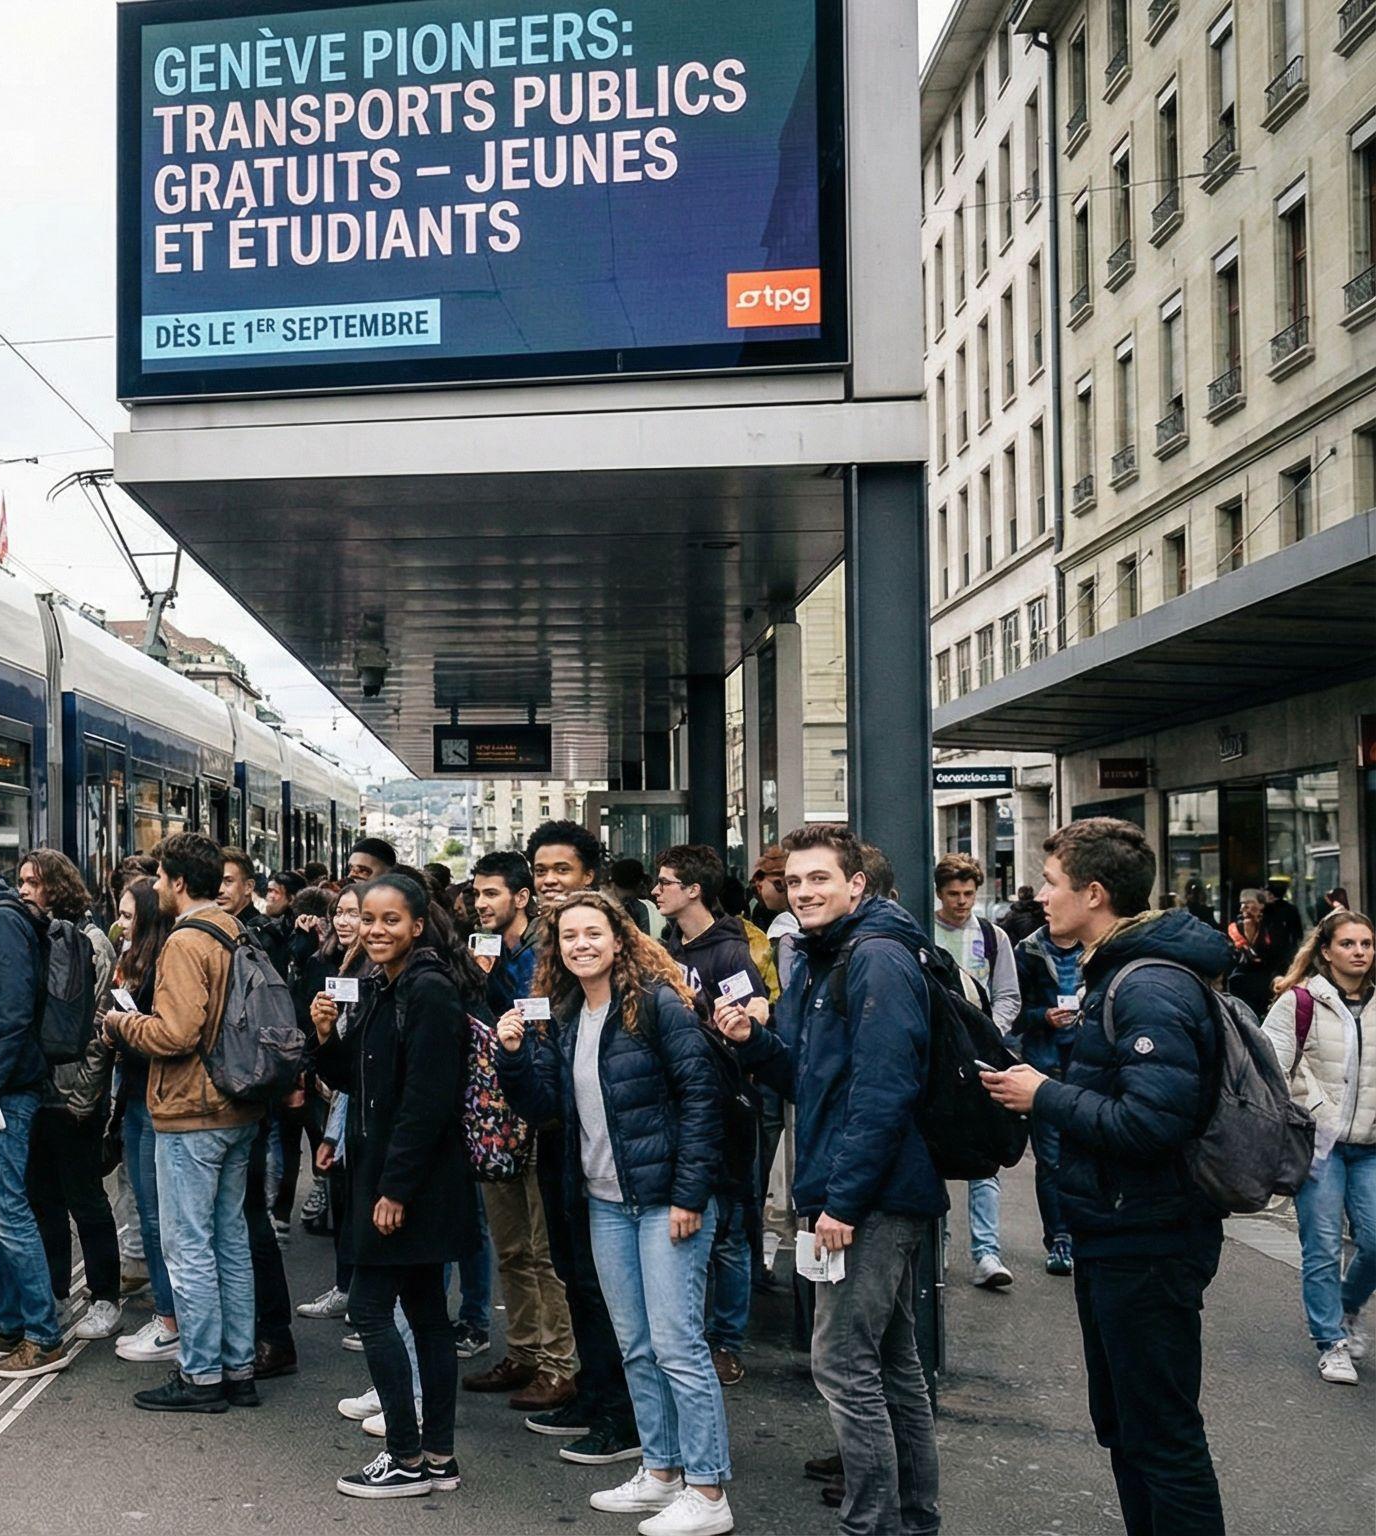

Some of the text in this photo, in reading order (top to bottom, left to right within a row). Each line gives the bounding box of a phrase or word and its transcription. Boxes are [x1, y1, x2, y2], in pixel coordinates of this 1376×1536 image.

[154, 9, 633, 96] GENÈVE PIONEERS:
[153, 58, 748, 154] TRANSPORTS PUBLICS
[154, 149, 401, 214] GRATUITS
[466, 126, 678, 194] JEUNES
[155, 200, 521, 274] ET ÉTUDIANTS
[155, 318, 201, 349] DÈS
[208, 321, 236, 346] LE
[281, 310, 429, 342] SEPTEMBRE
